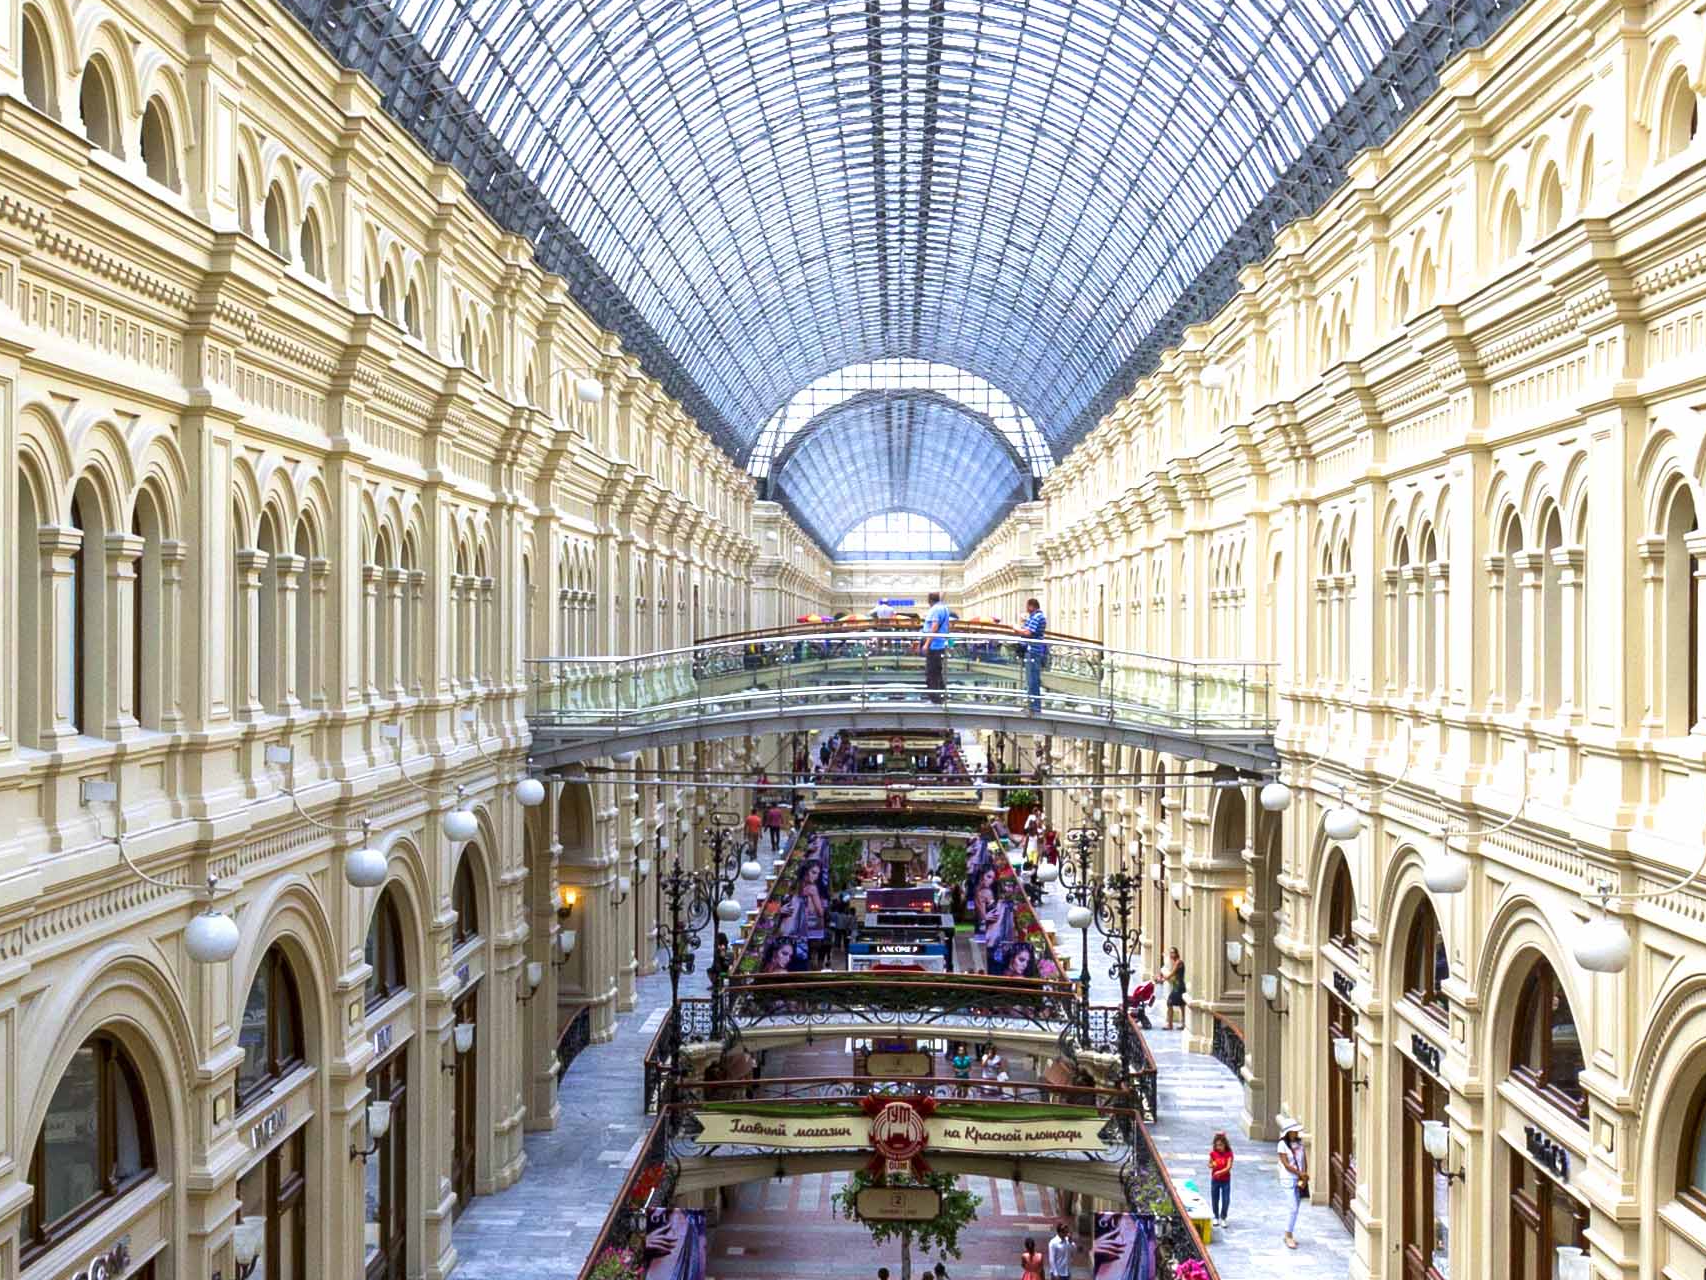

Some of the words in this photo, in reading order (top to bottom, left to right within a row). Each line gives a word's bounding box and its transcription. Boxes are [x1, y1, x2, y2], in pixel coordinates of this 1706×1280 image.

[729, 1118, 788, 1137] Главный
[793, 1126, 852, 1137] магазин
[944, 1127, 961, 1139] на
[965, 1126, 1023, 1144] Красной
[1025, 1127, 1083, 1142] площади
